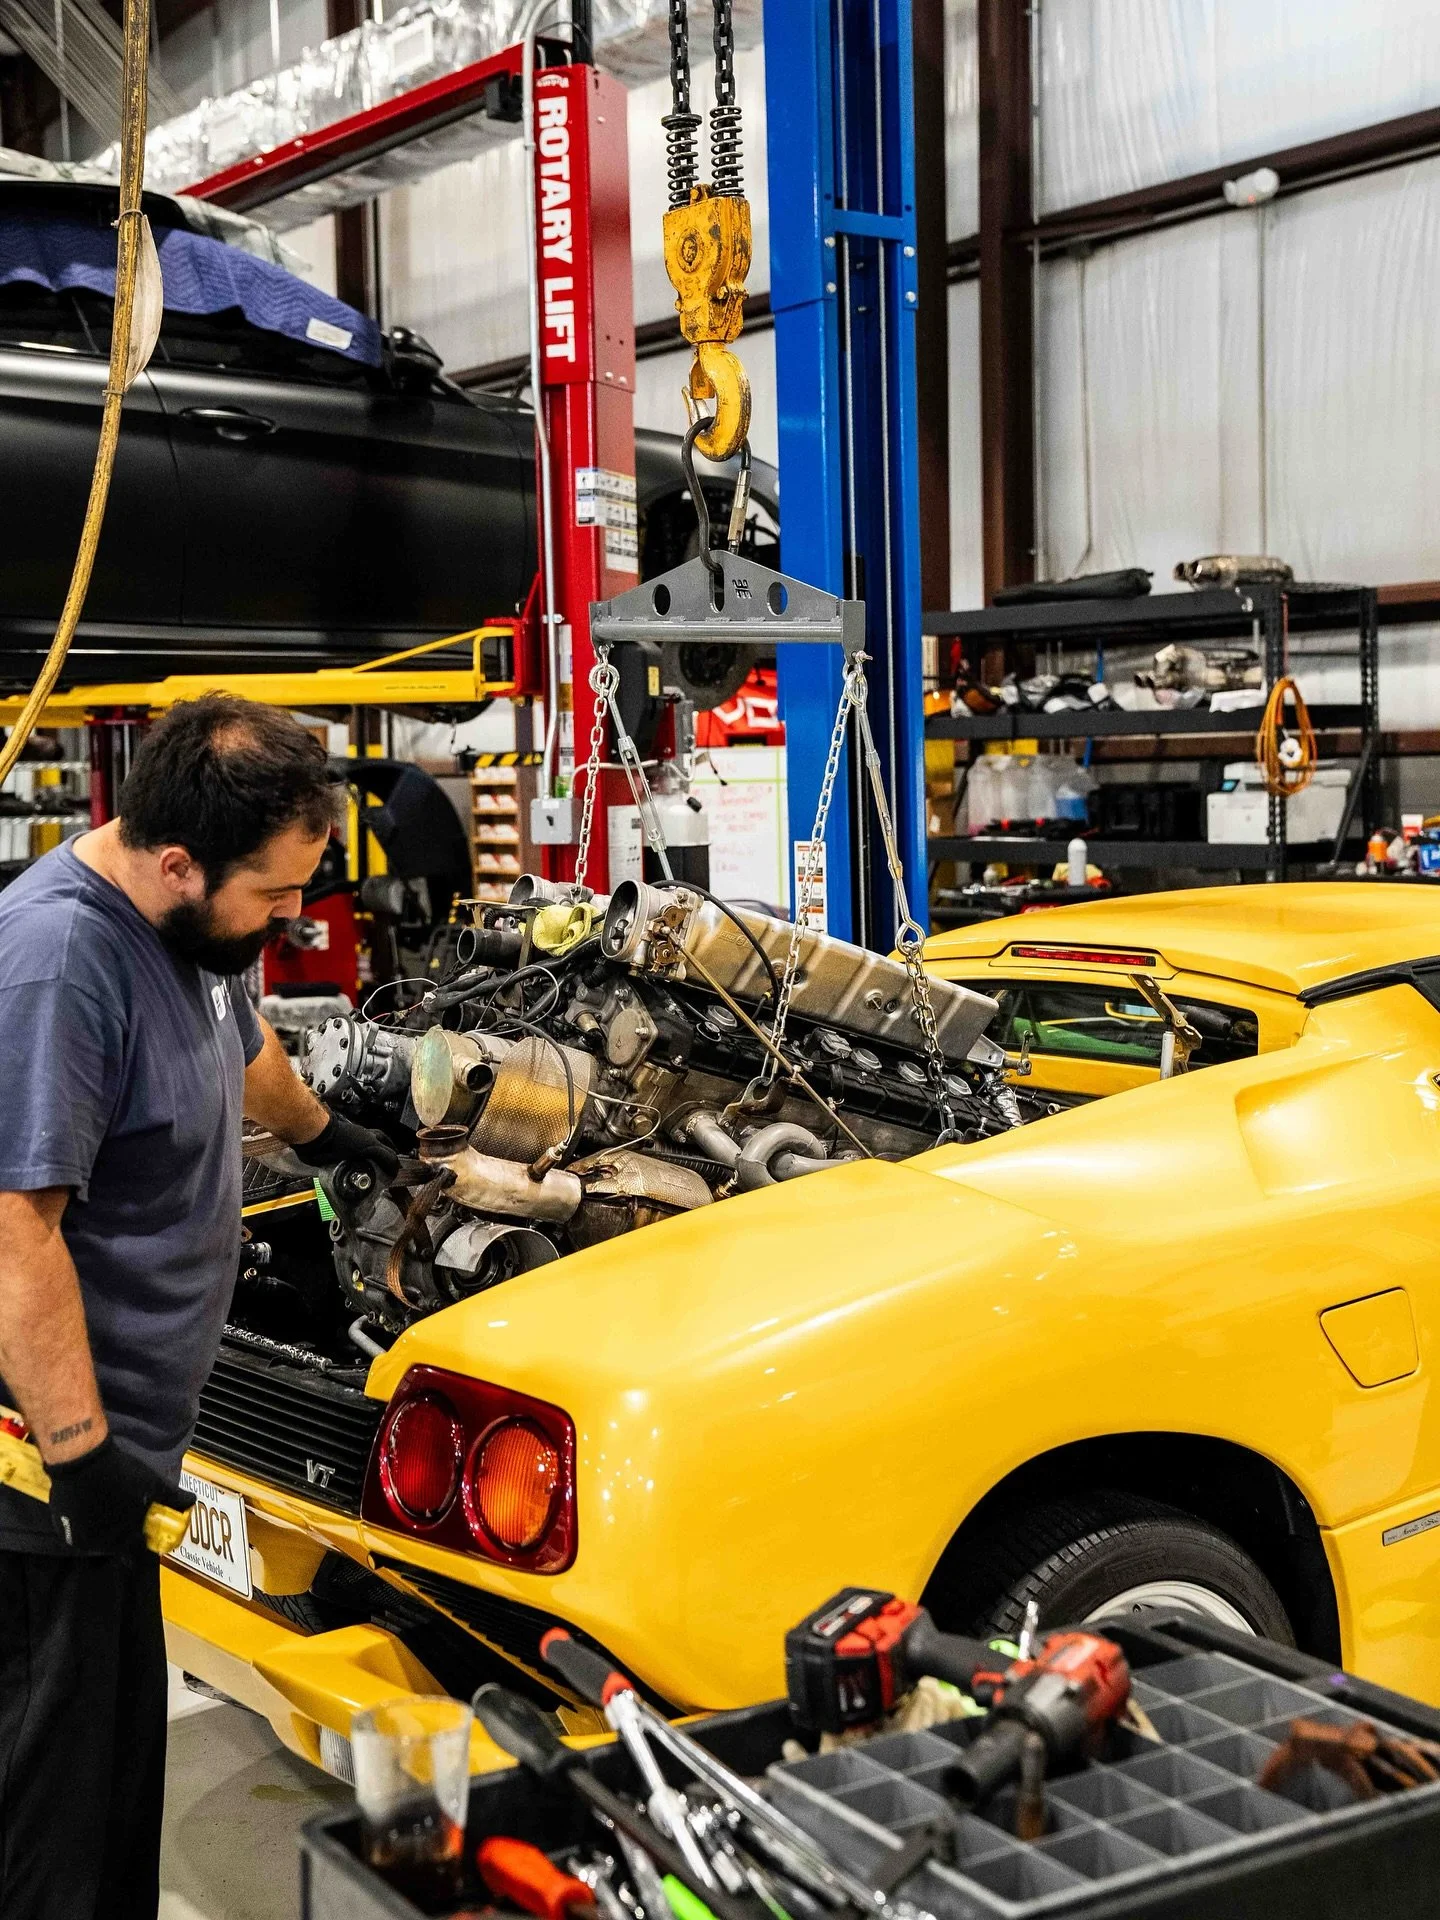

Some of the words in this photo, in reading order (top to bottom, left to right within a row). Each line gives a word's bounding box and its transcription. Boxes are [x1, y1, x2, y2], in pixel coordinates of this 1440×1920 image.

[538, 95, 573, 265] ROTARY
[544, 276, 576, 363] LIFT
[306, 1459, 336, 1488] VT
[180, 1545, 201, 1566] Classic
[201, 1556, 224, 1578] Vehicle
